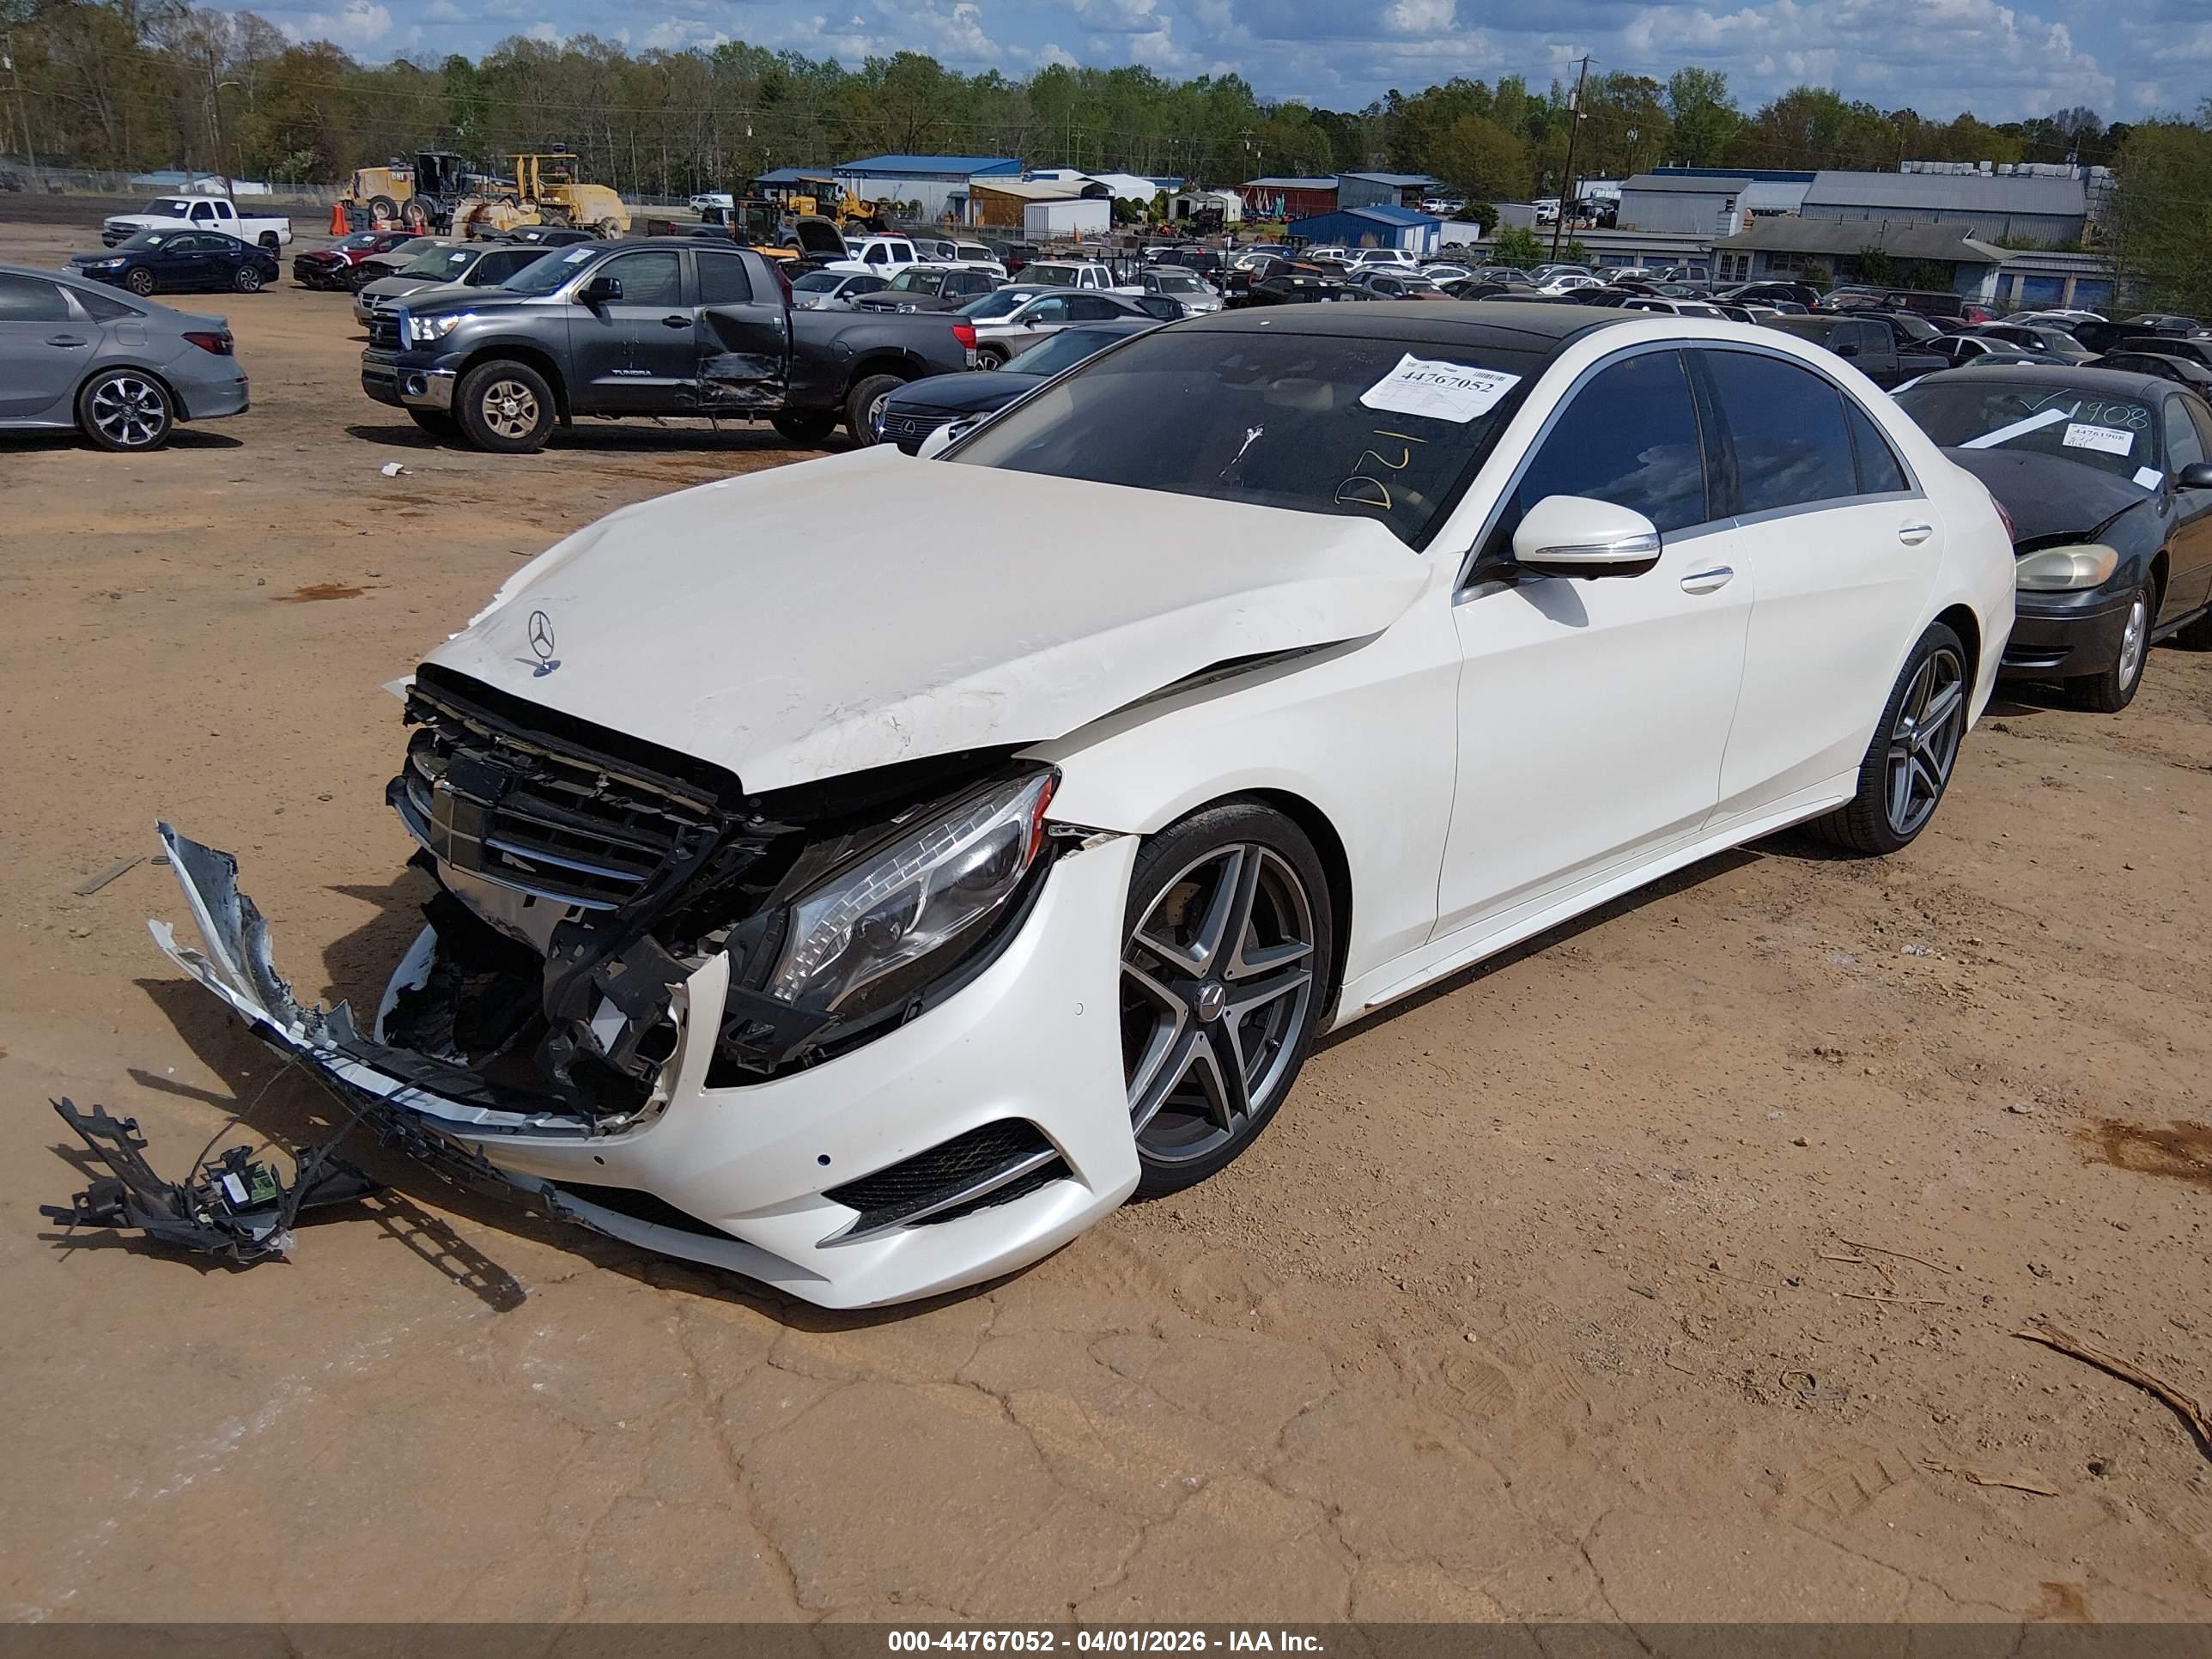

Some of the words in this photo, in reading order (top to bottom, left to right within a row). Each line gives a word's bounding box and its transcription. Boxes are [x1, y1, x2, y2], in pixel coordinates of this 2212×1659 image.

[392, 172, 404, 180] CAT
[1401, 371, 1495, 393] 44767052
[2068, 400, 2148, 429] 1908
